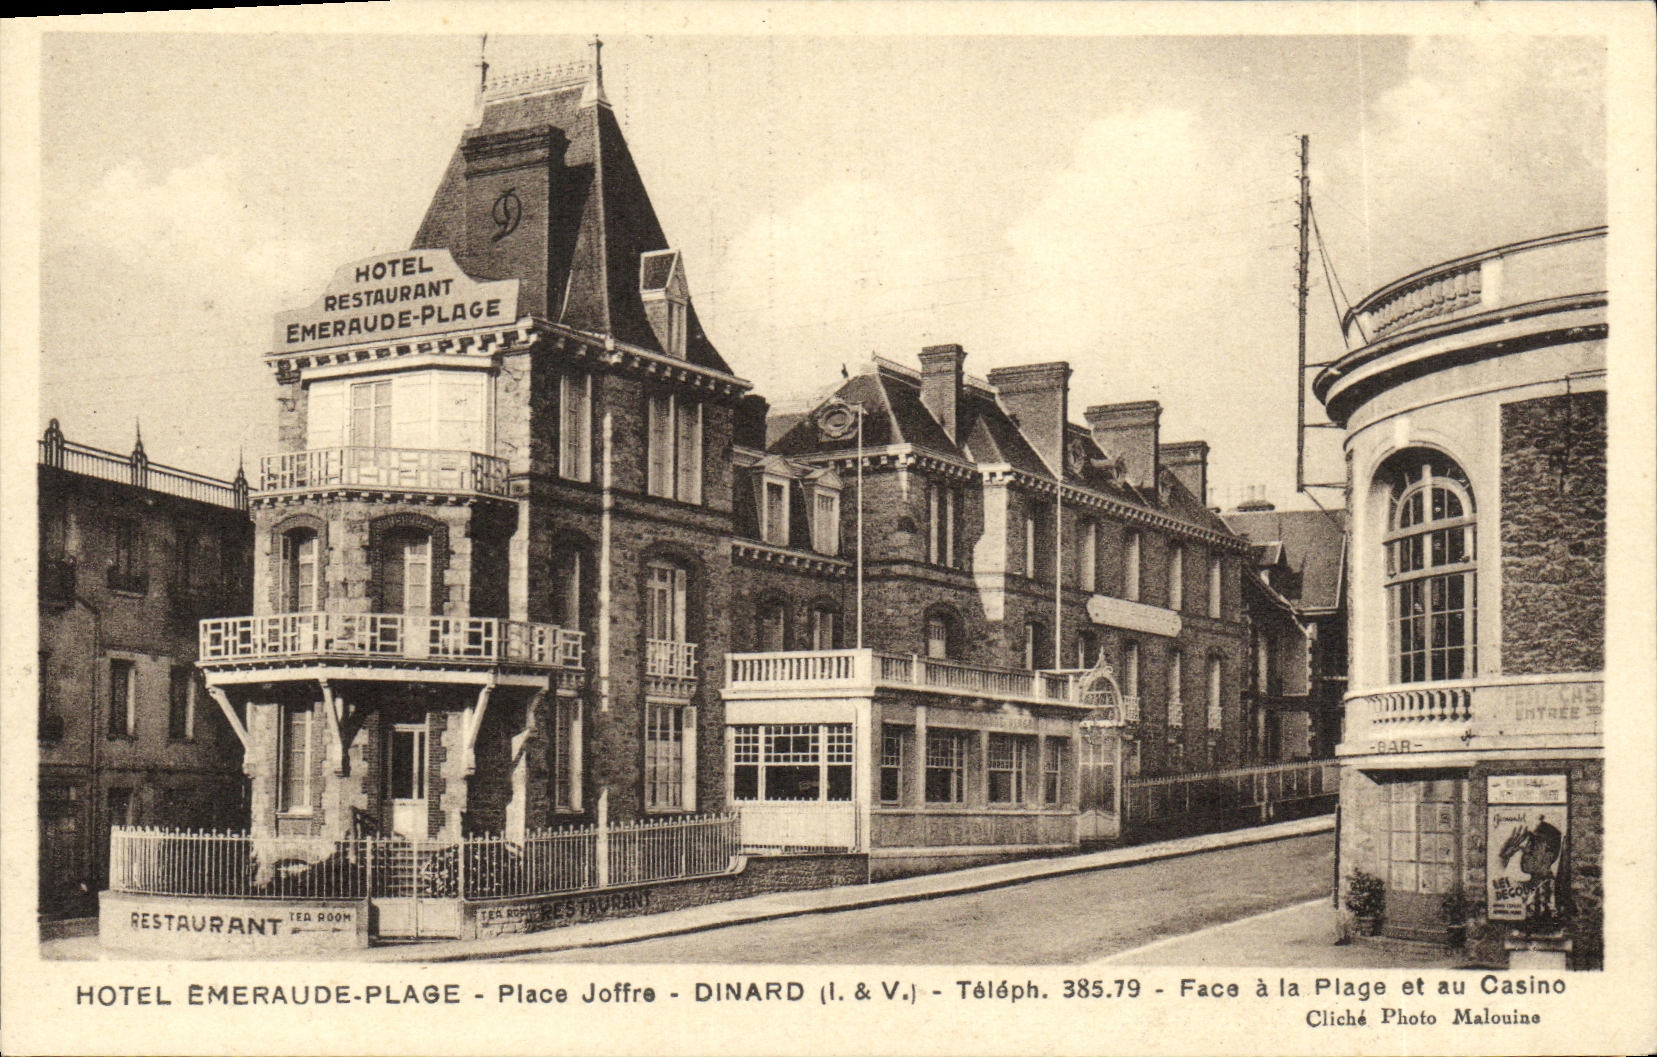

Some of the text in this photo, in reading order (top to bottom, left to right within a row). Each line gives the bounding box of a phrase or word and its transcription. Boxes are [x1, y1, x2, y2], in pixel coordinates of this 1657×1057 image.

[355, 256, 434, 283] HOTEL
[324, 278, 454, 312] RESTAURANT
[286, 298, 501, 344] EMERAUDE-PLAGE
[130, 911, 283, 936] RESTAURANT
[289, 912, 351, 923] TEA ROOM
